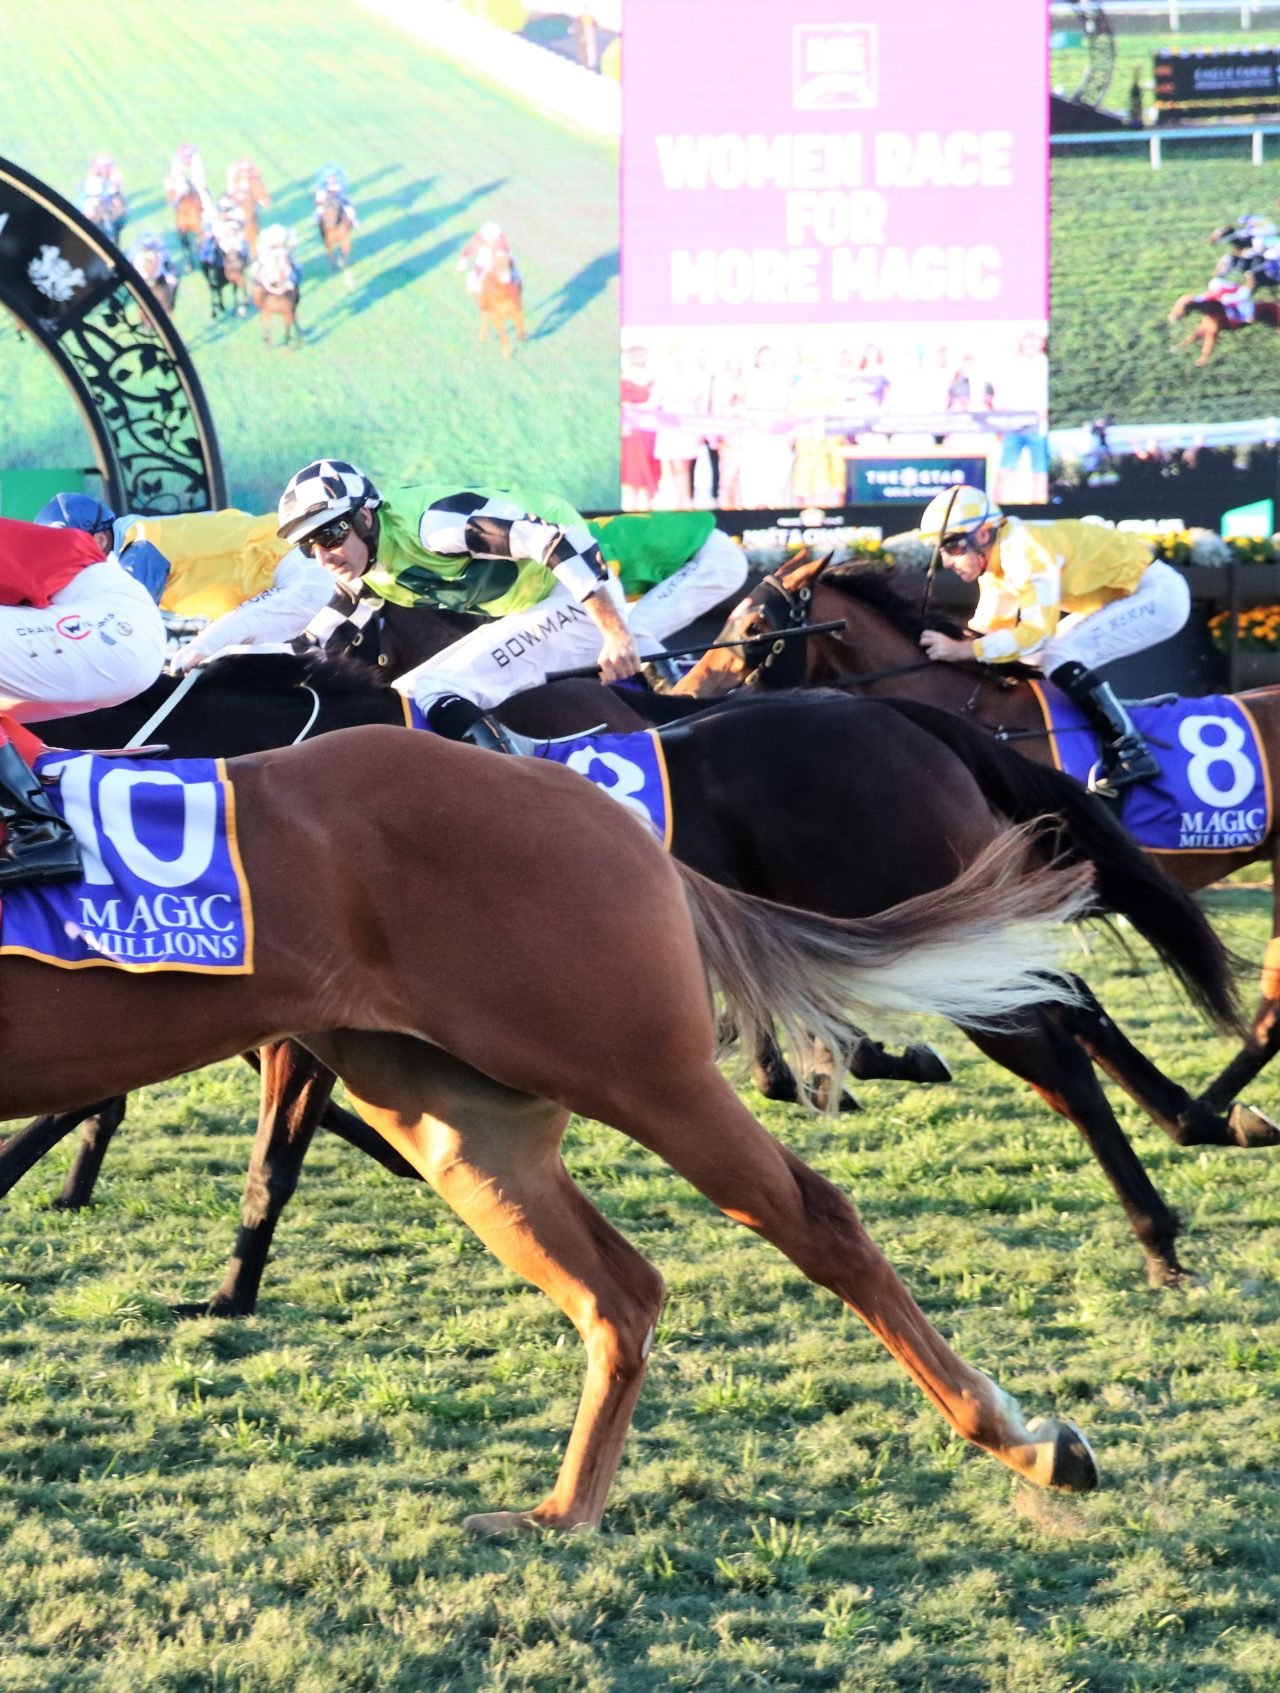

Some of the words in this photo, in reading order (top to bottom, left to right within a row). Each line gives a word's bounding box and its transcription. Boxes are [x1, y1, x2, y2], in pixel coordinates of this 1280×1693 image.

[655, 132, 863, 190] WOMEN
[874, 130, 1014, 188] RACE
[785, 189, 888, 246] FOR
[670, 247, 820, 304] MORE
[831, 244, 1003, 302] MAGIC
[492, 604, 588, 669] BOWMAN
[1178, 715, 1257, 808] 8
[40, 754, 218, 889] 10
[1179, 808, 1266, 834] MAGIC
[78, 893, 236, 934] MAGIC
[81, 930, 239, 960] MILLIONS
